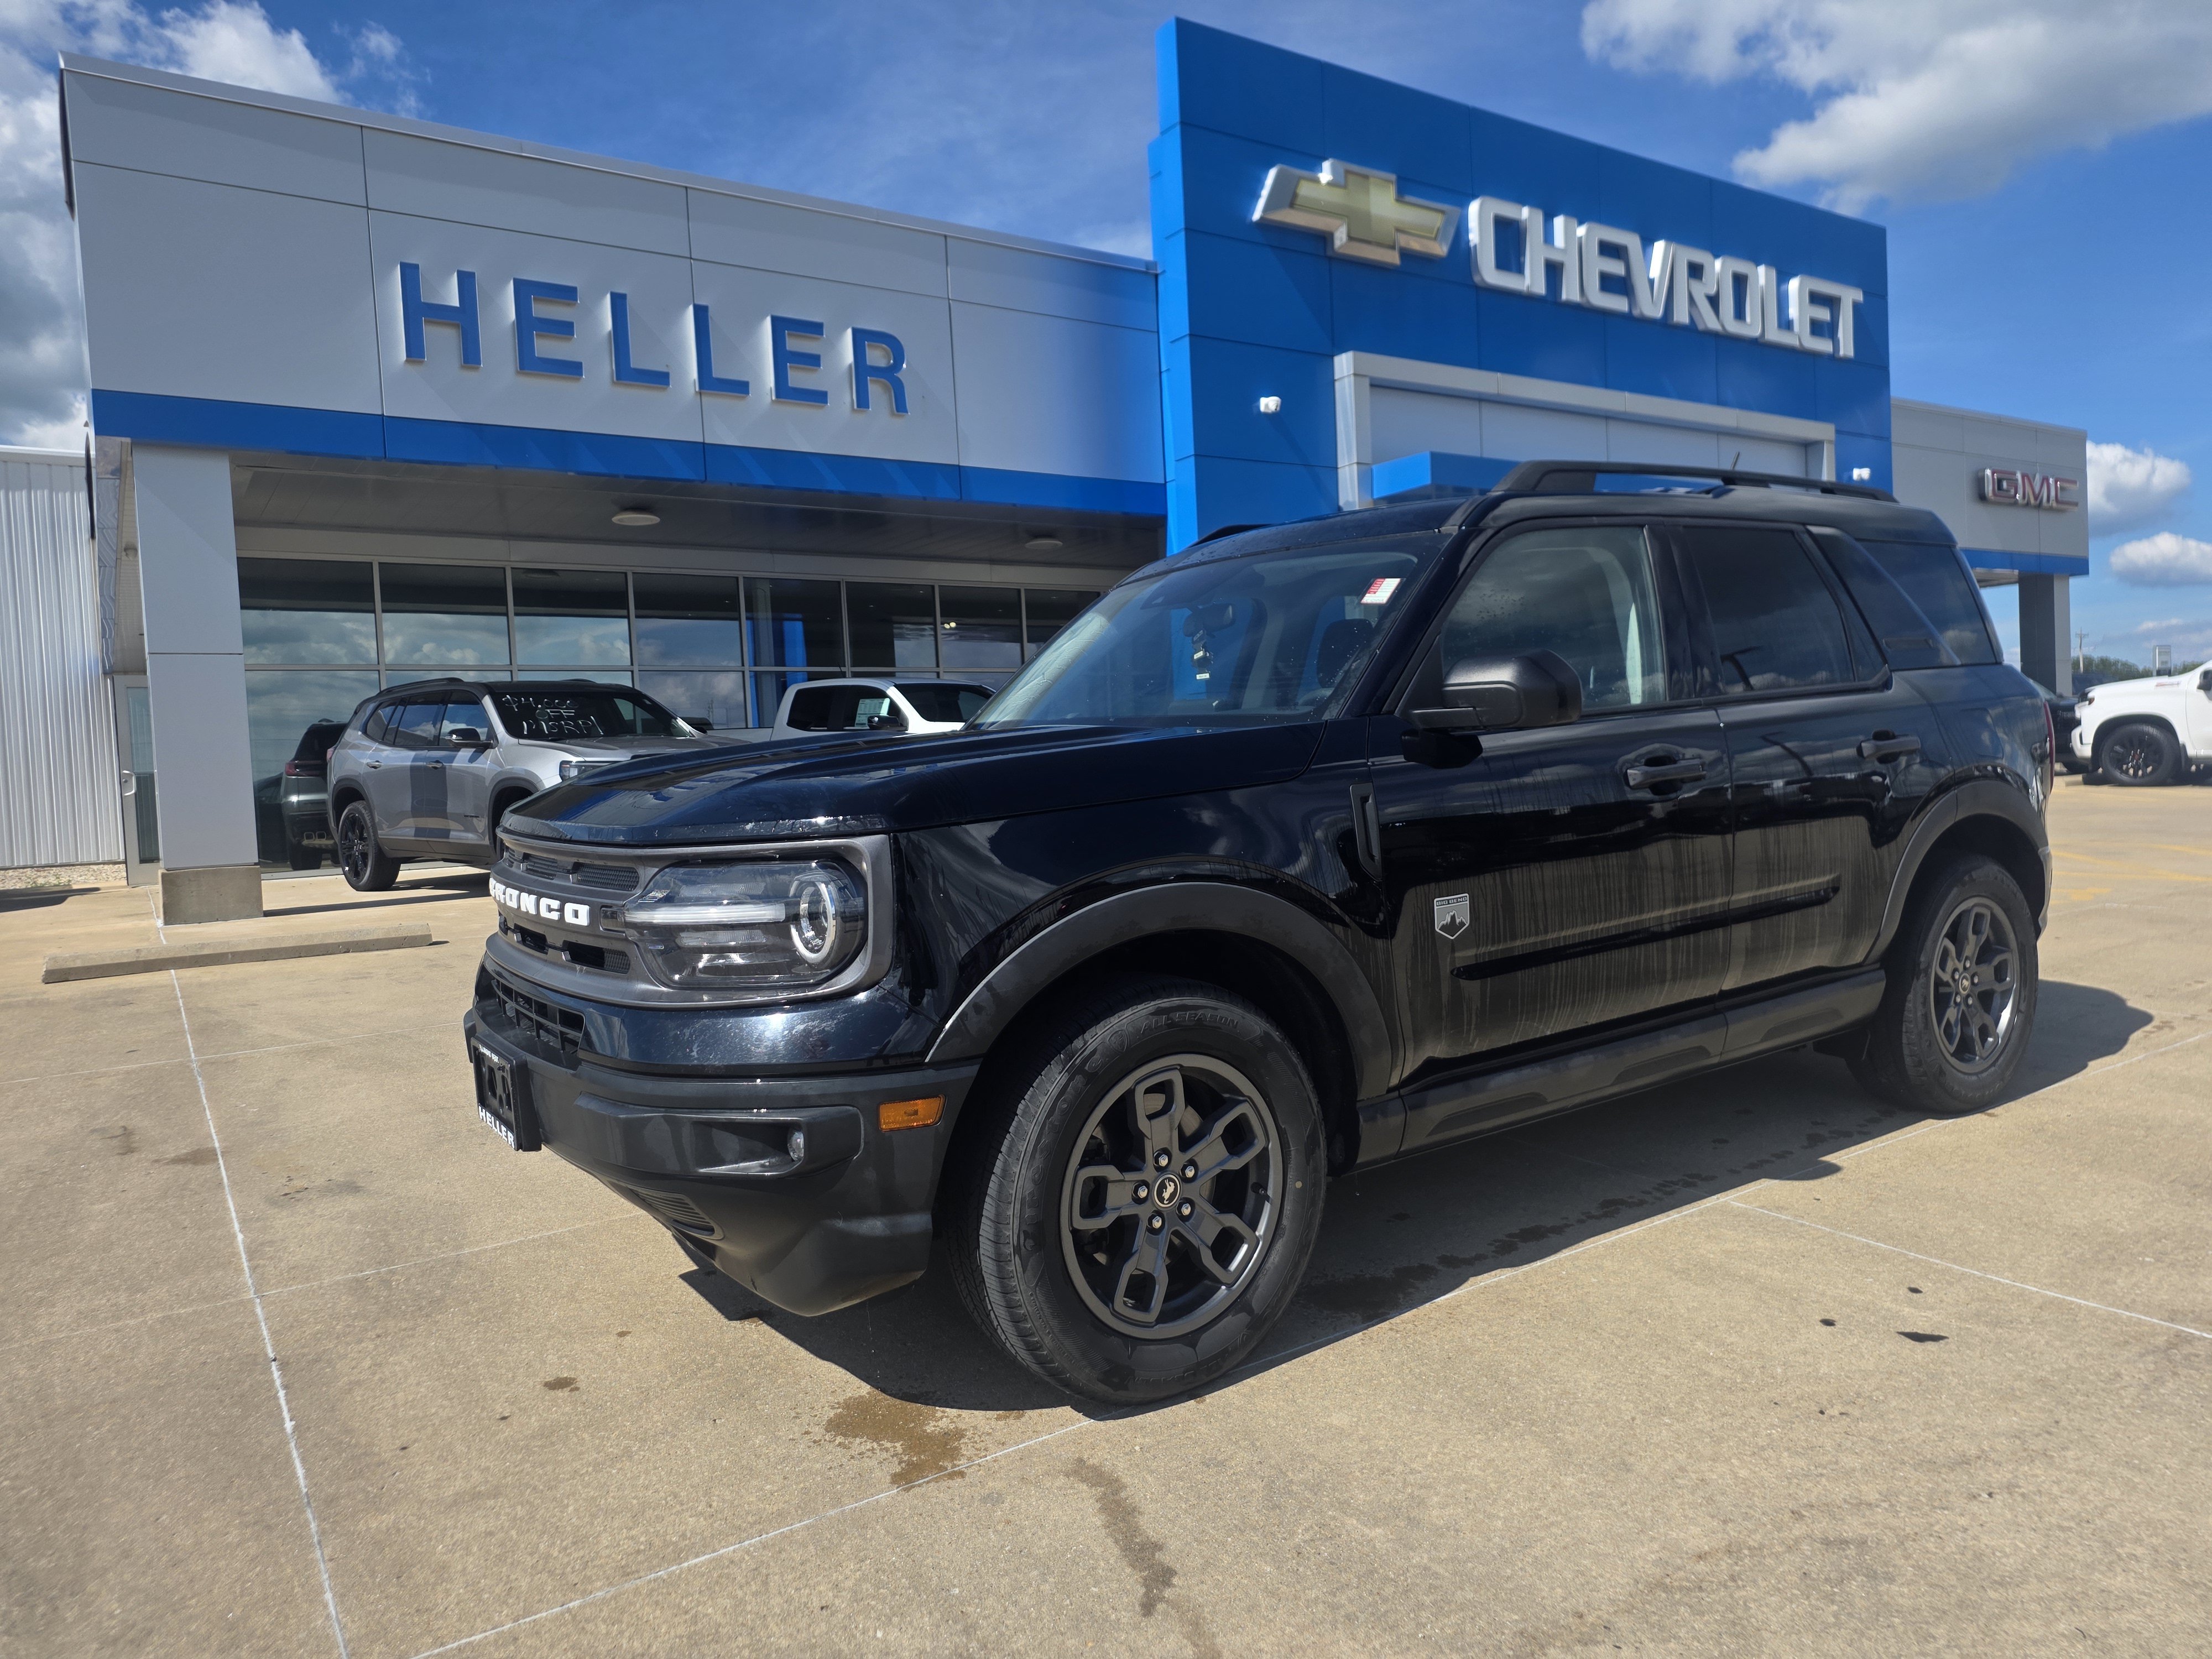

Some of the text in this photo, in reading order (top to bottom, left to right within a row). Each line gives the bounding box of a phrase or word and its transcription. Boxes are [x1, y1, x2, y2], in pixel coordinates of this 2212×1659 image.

[1468, 196, 1864, 358] CHEVROLET
[399, 261, 910, 416] HELLER
[1983, 468, 2079, 510] GMC
[535, 709, 575, 719] OFF
[489, 877, 590, 926] BRONCO
[478, 1105, 515, 1149] HELLER
